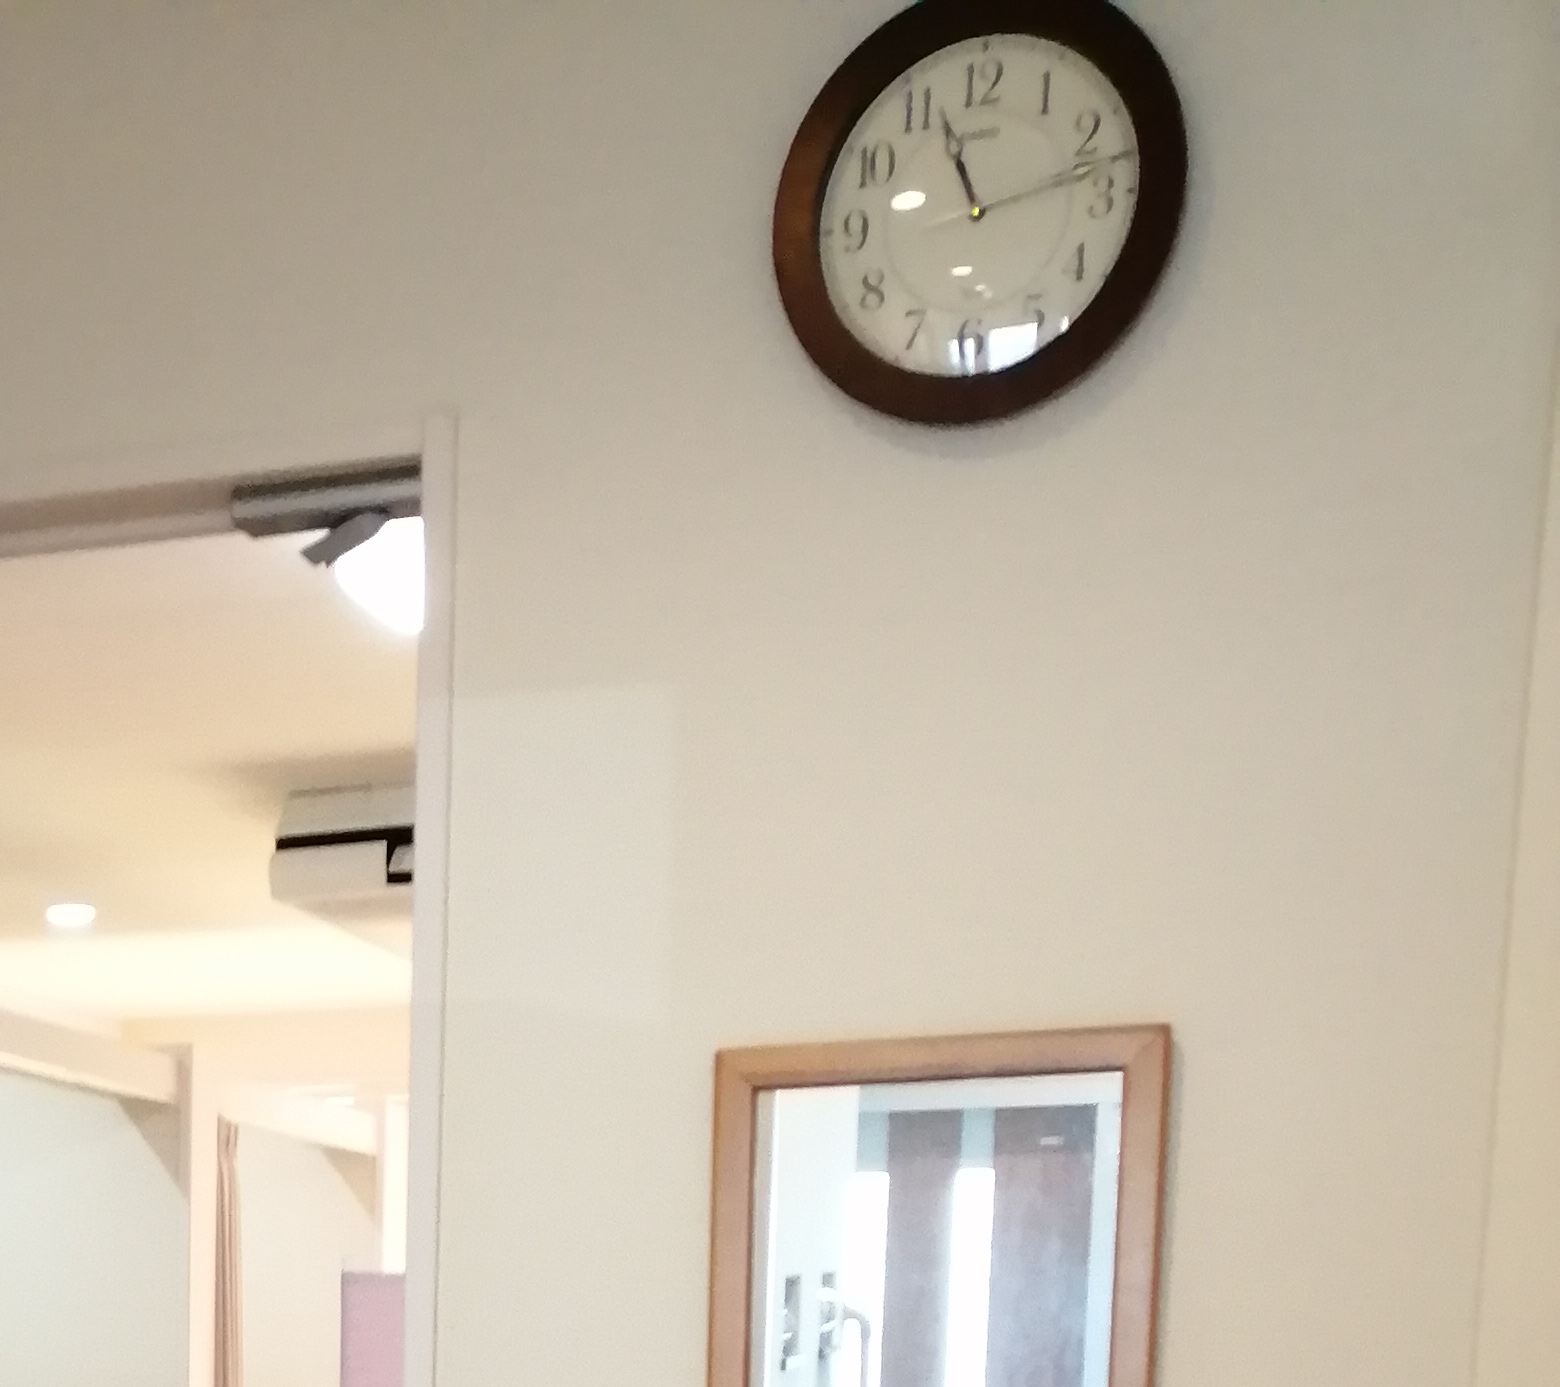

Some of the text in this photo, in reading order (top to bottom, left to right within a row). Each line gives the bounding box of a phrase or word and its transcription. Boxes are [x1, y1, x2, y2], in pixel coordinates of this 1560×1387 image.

[964, 60, 1003, 108] 12
[1040, 70, 1051, 115] 1
[904, 87, 931, 133] 11
[1075, 111, 1101, 156] 2
[859, 140, 896, 189] 10
[1089, 174, 1114, 219] 3
[843, 208, 869, 253] 9
[1061, 242, 1086, 281] 4
[859, 267, 885, 311] 8
[905, 308, 928, 351] 7
[957, 318, 984, 359] 6
